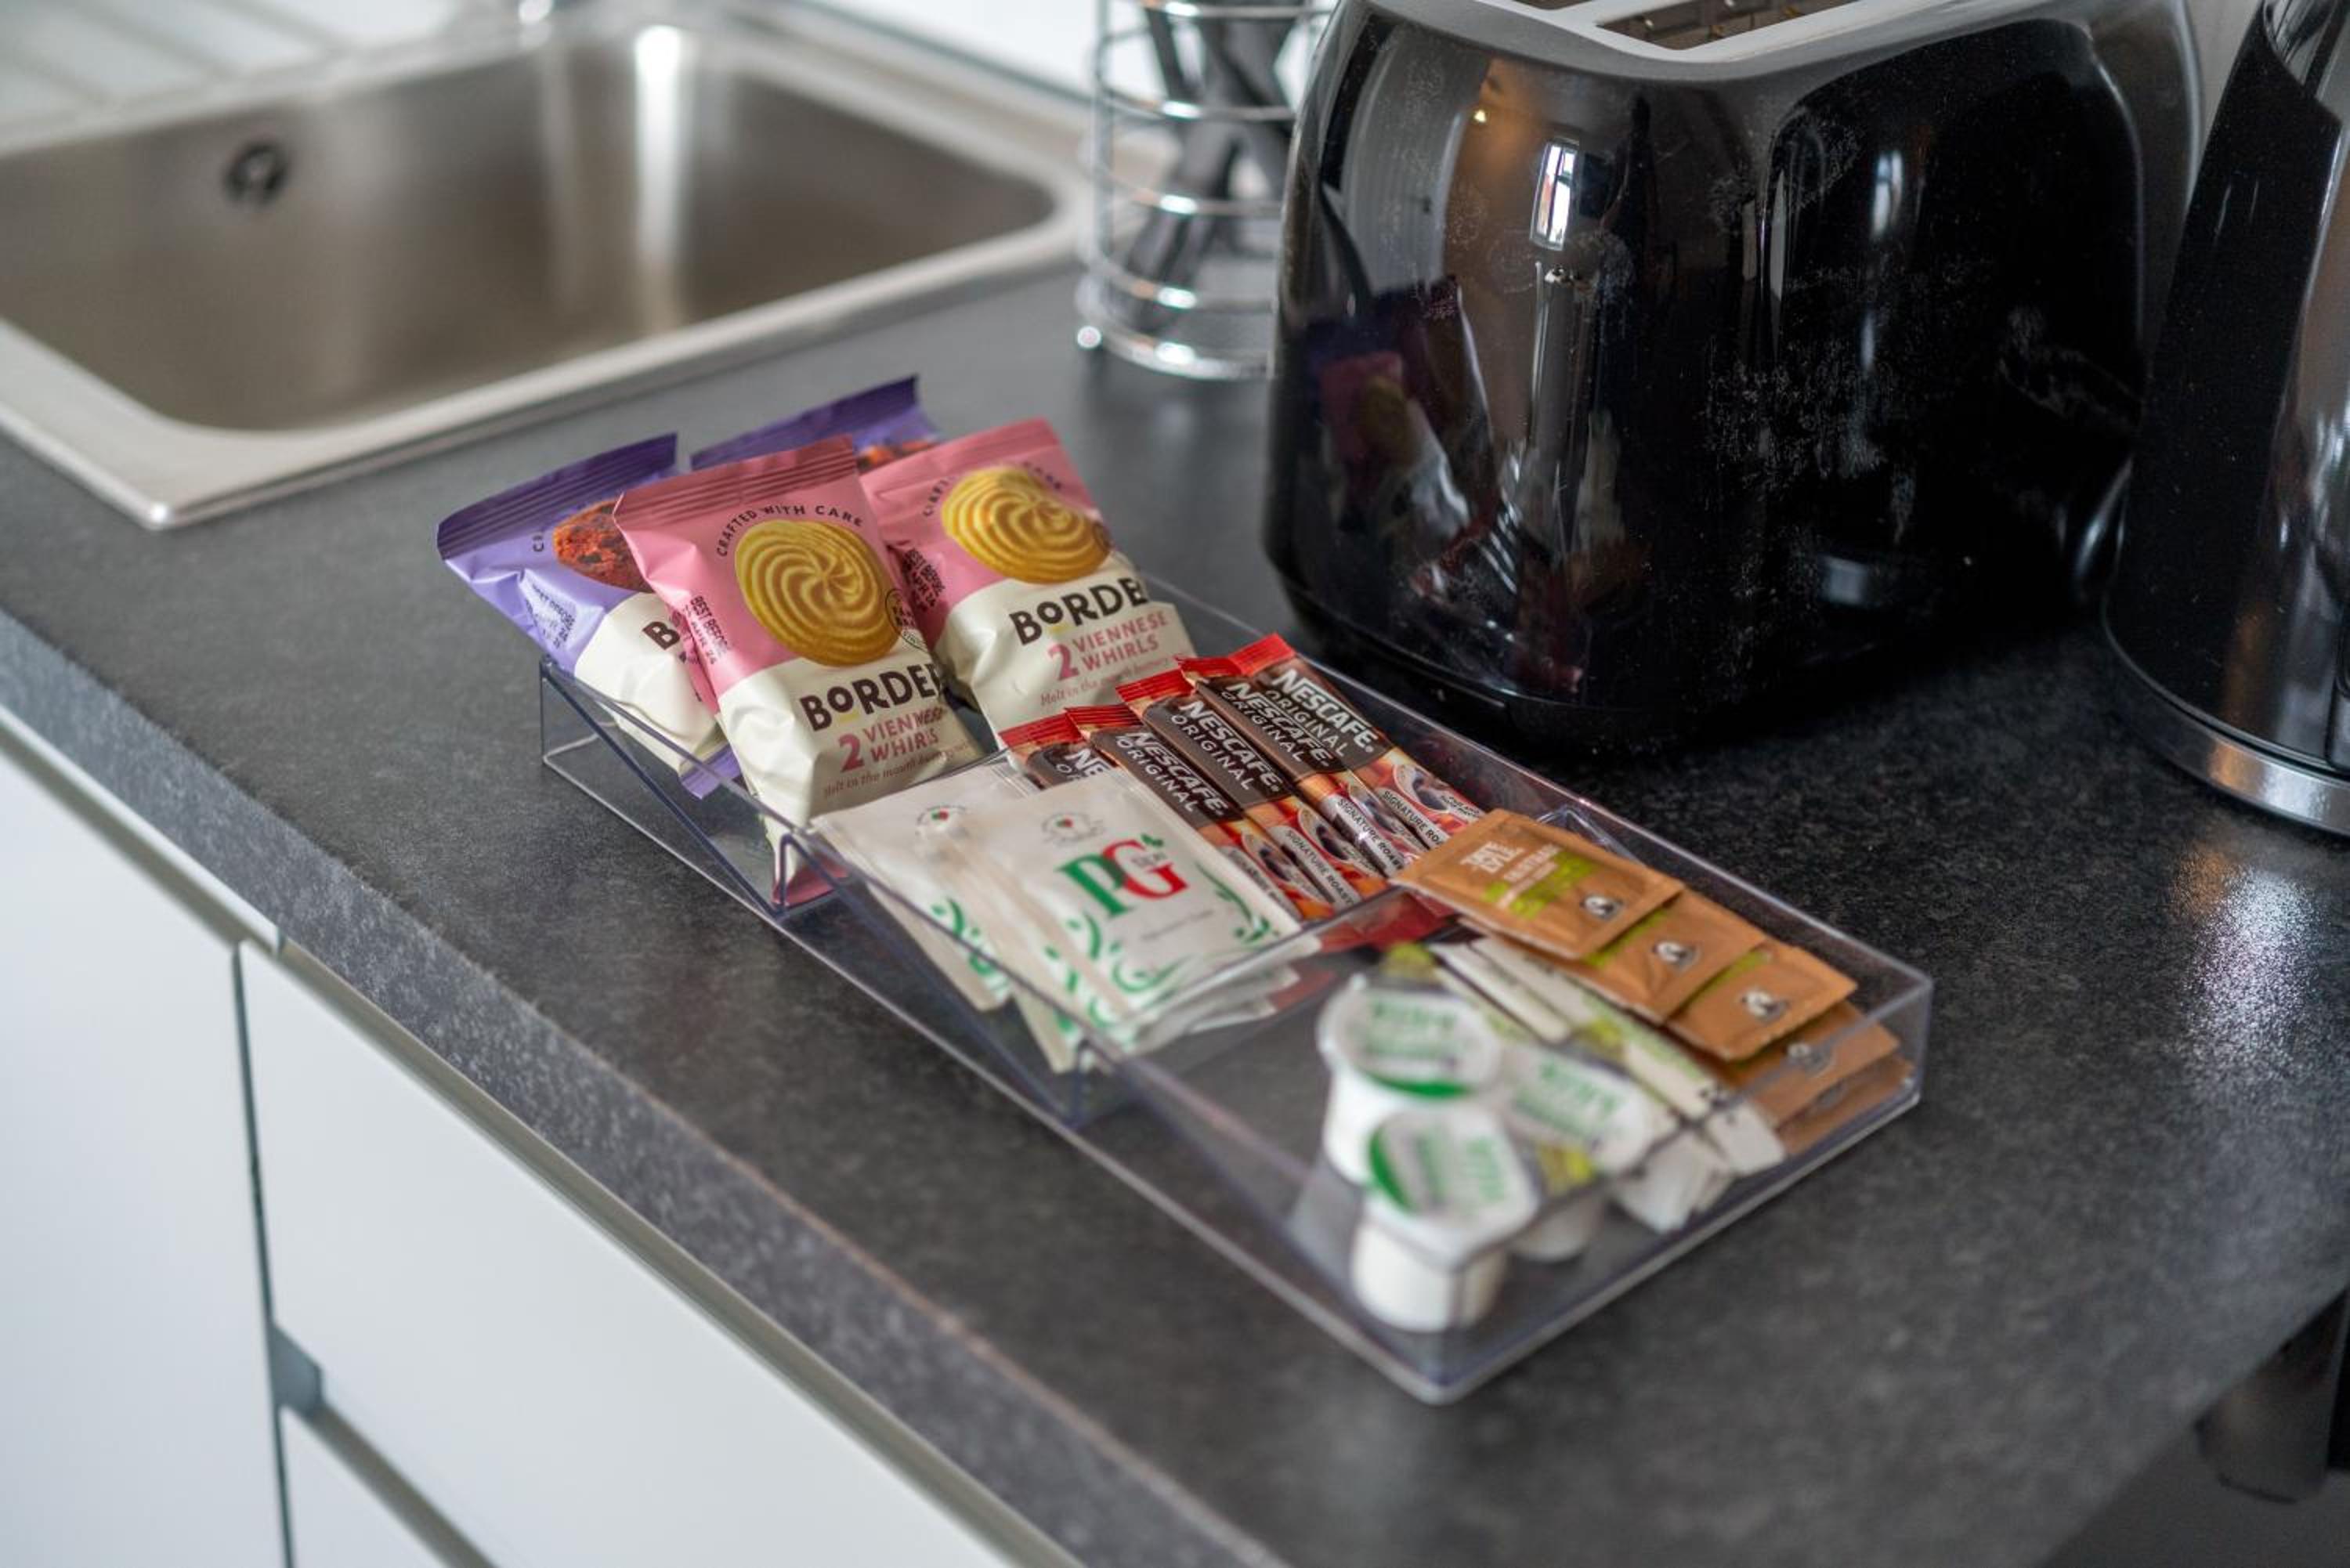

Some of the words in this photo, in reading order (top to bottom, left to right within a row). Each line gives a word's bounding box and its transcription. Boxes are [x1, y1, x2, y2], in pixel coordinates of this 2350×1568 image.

[717, 510, 757, 556] CRAFTED
[764, 505, 805, 515] WITH
[815, 505, 862, 526] CARE
[1009, 578, 1148, 645] BORDE
[1048, 643, 1079, 681] 2
[1072, 610, 1168, 652] VIENNESE
[1083, 636, 1159, 671] WHIRLS
[839, 733, 864, 772] 2
[870, 728, 938, 762] WHIRS
[1171, 714, 1254, 790] ORIGINAL
[1221, 692, 1303, 762] ORIGINAL
[1265, 690, 1349, 757] ORIGINAL
[1115, 737, 1198, 812] ORIGINAL
[1338, 798, 1379, 843] SIGNATURE
[1383, 791, 1427, 833] SIGNATURE
[1054, 839, 1188, 920] PG
